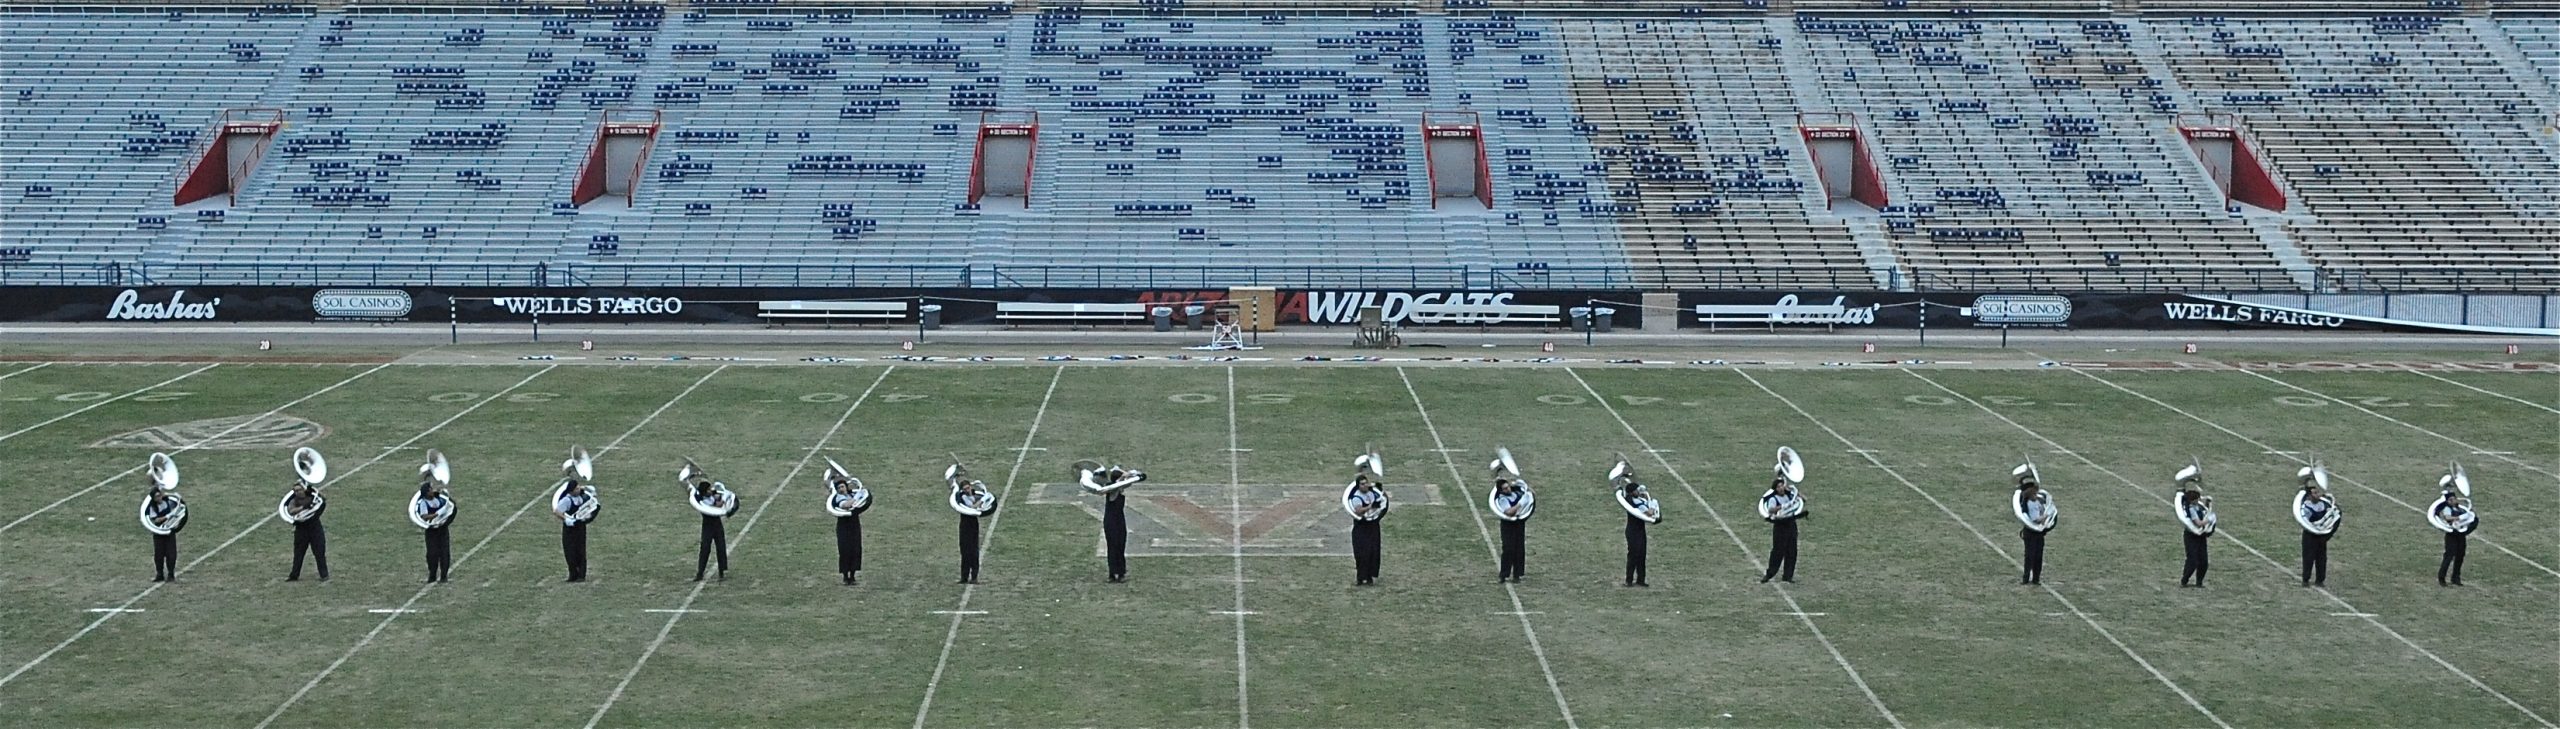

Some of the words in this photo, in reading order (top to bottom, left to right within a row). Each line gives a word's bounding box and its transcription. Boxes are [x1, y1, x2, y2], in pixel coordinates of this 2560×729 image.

[106, 288, 221, 320] Bashas'
[323, 297, 346, 308] SOL
[349, 297, 402, 308] CASINOS
[504, 297, 592, 314] WELLS
[598, 297, 682, 314] FARGO
[2008, 303, 2062, 314] CASINOS
[2164, 303, 2252, 322] WELLS
